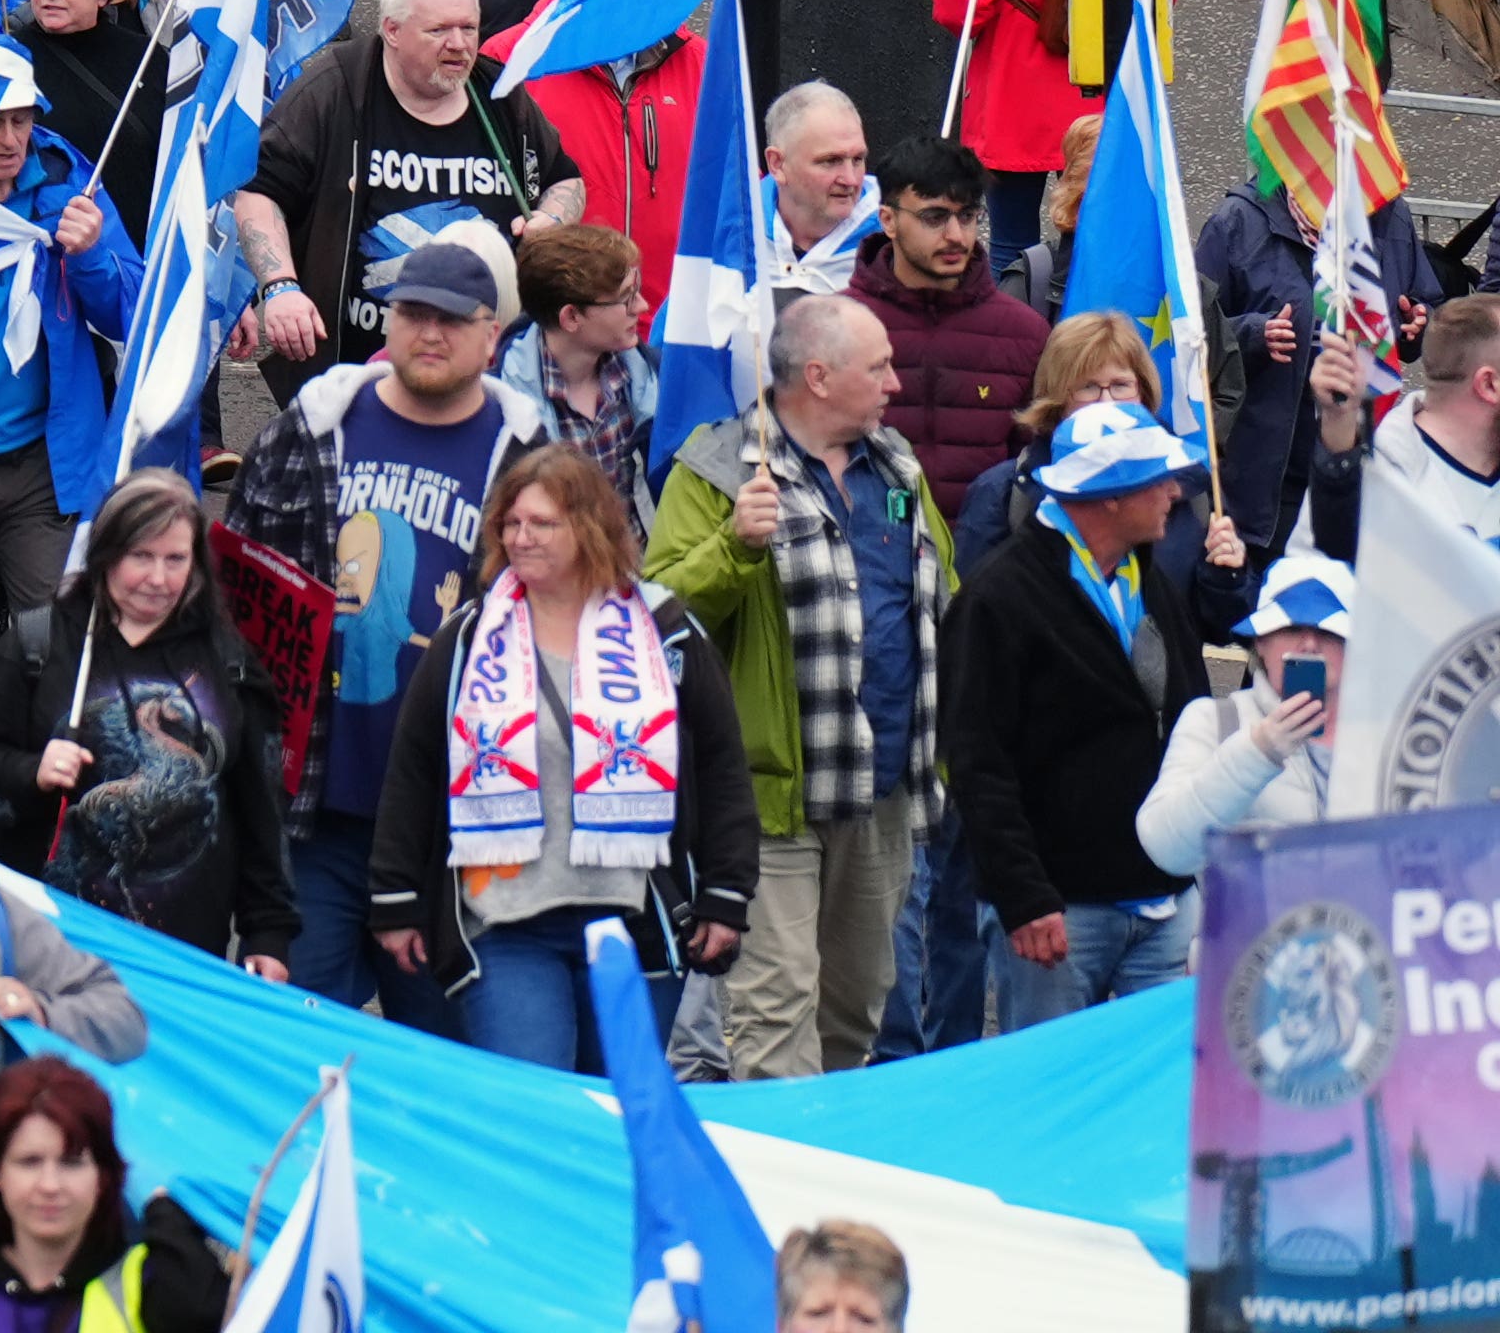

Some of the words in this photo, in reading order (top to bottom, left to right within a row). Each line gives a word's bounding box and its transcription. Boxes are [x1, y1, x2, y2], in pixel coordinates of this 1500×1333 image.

[368, 149, 512, 196] SCOTTISH
[343, 462, 349, 474] I
[354, 461, 379, 474] AM
[383, 461, 411, 477] THE
[414, 466, 461, 494] GREAT
[220, 556, 318, 634] BREAK
[261, 615, 315, 676] THE
